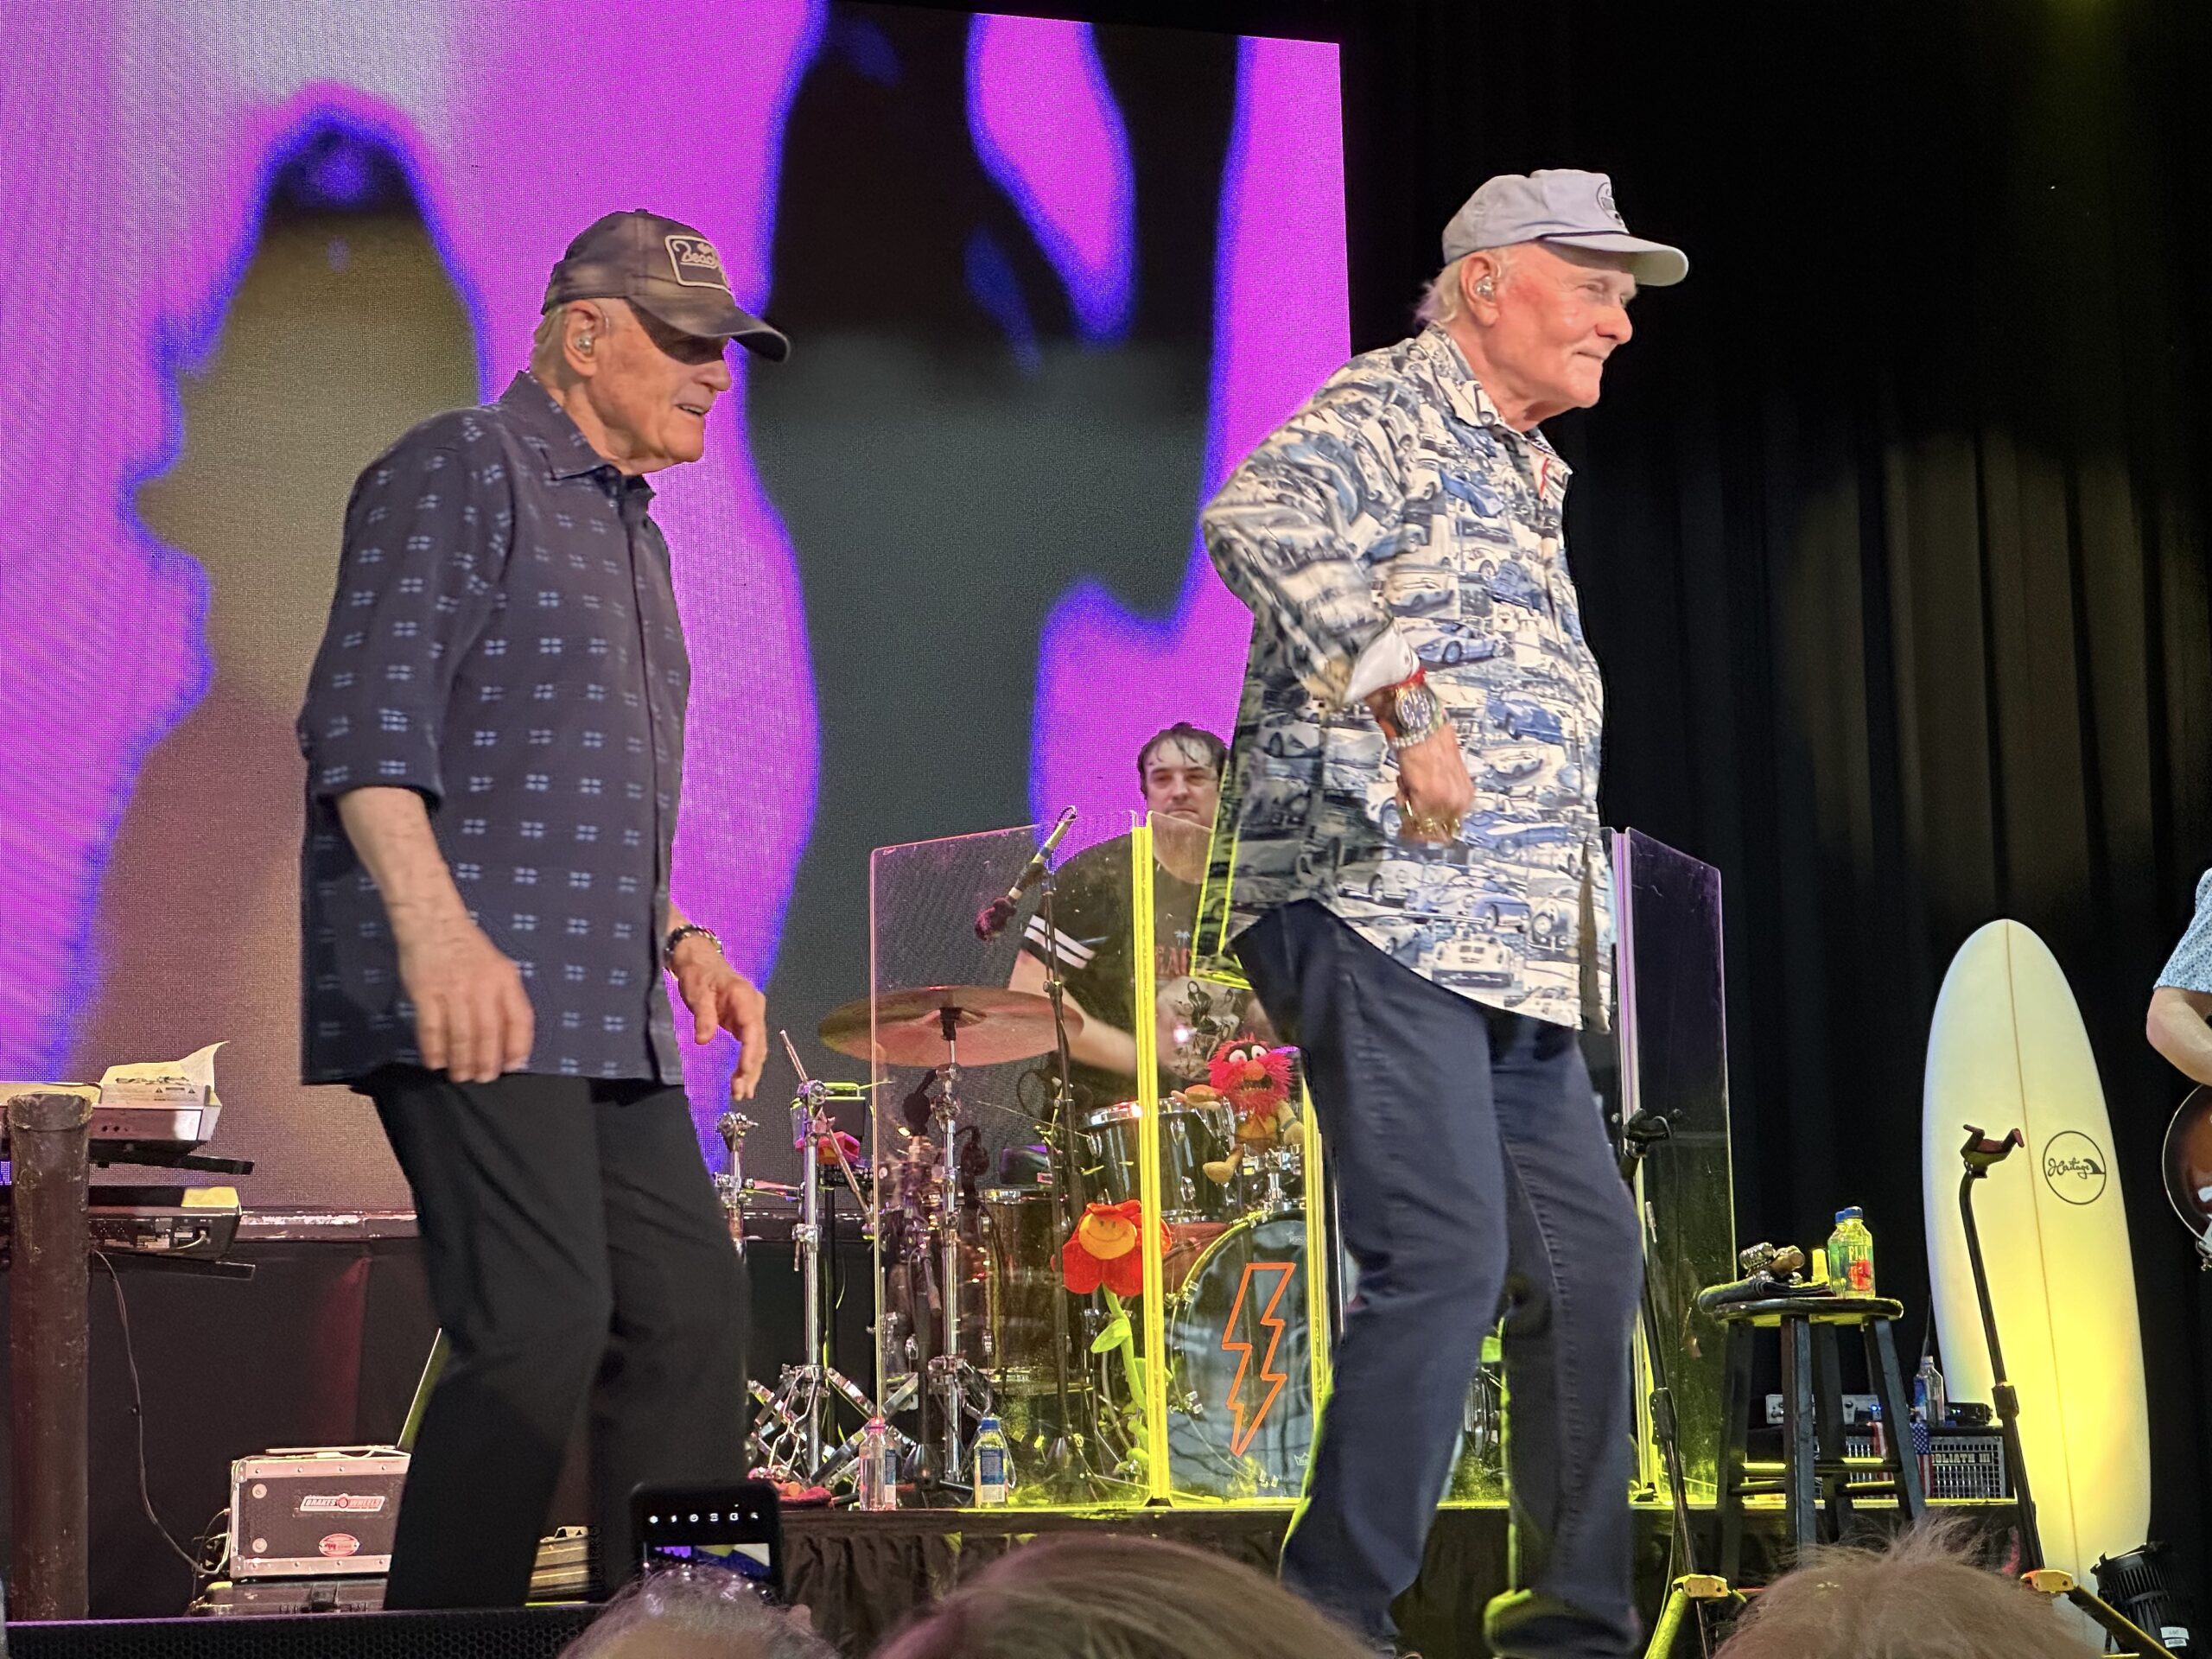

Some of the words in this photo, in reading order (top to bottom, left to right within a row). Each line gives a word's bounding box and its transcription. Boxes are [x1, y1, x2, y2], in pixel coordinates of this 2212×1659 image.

[2047, 1157, 2089, 1179] Heritage
[1848, 1245, 1868, 1261] FIJI
[1979, 1452, 1991, 1463] III
